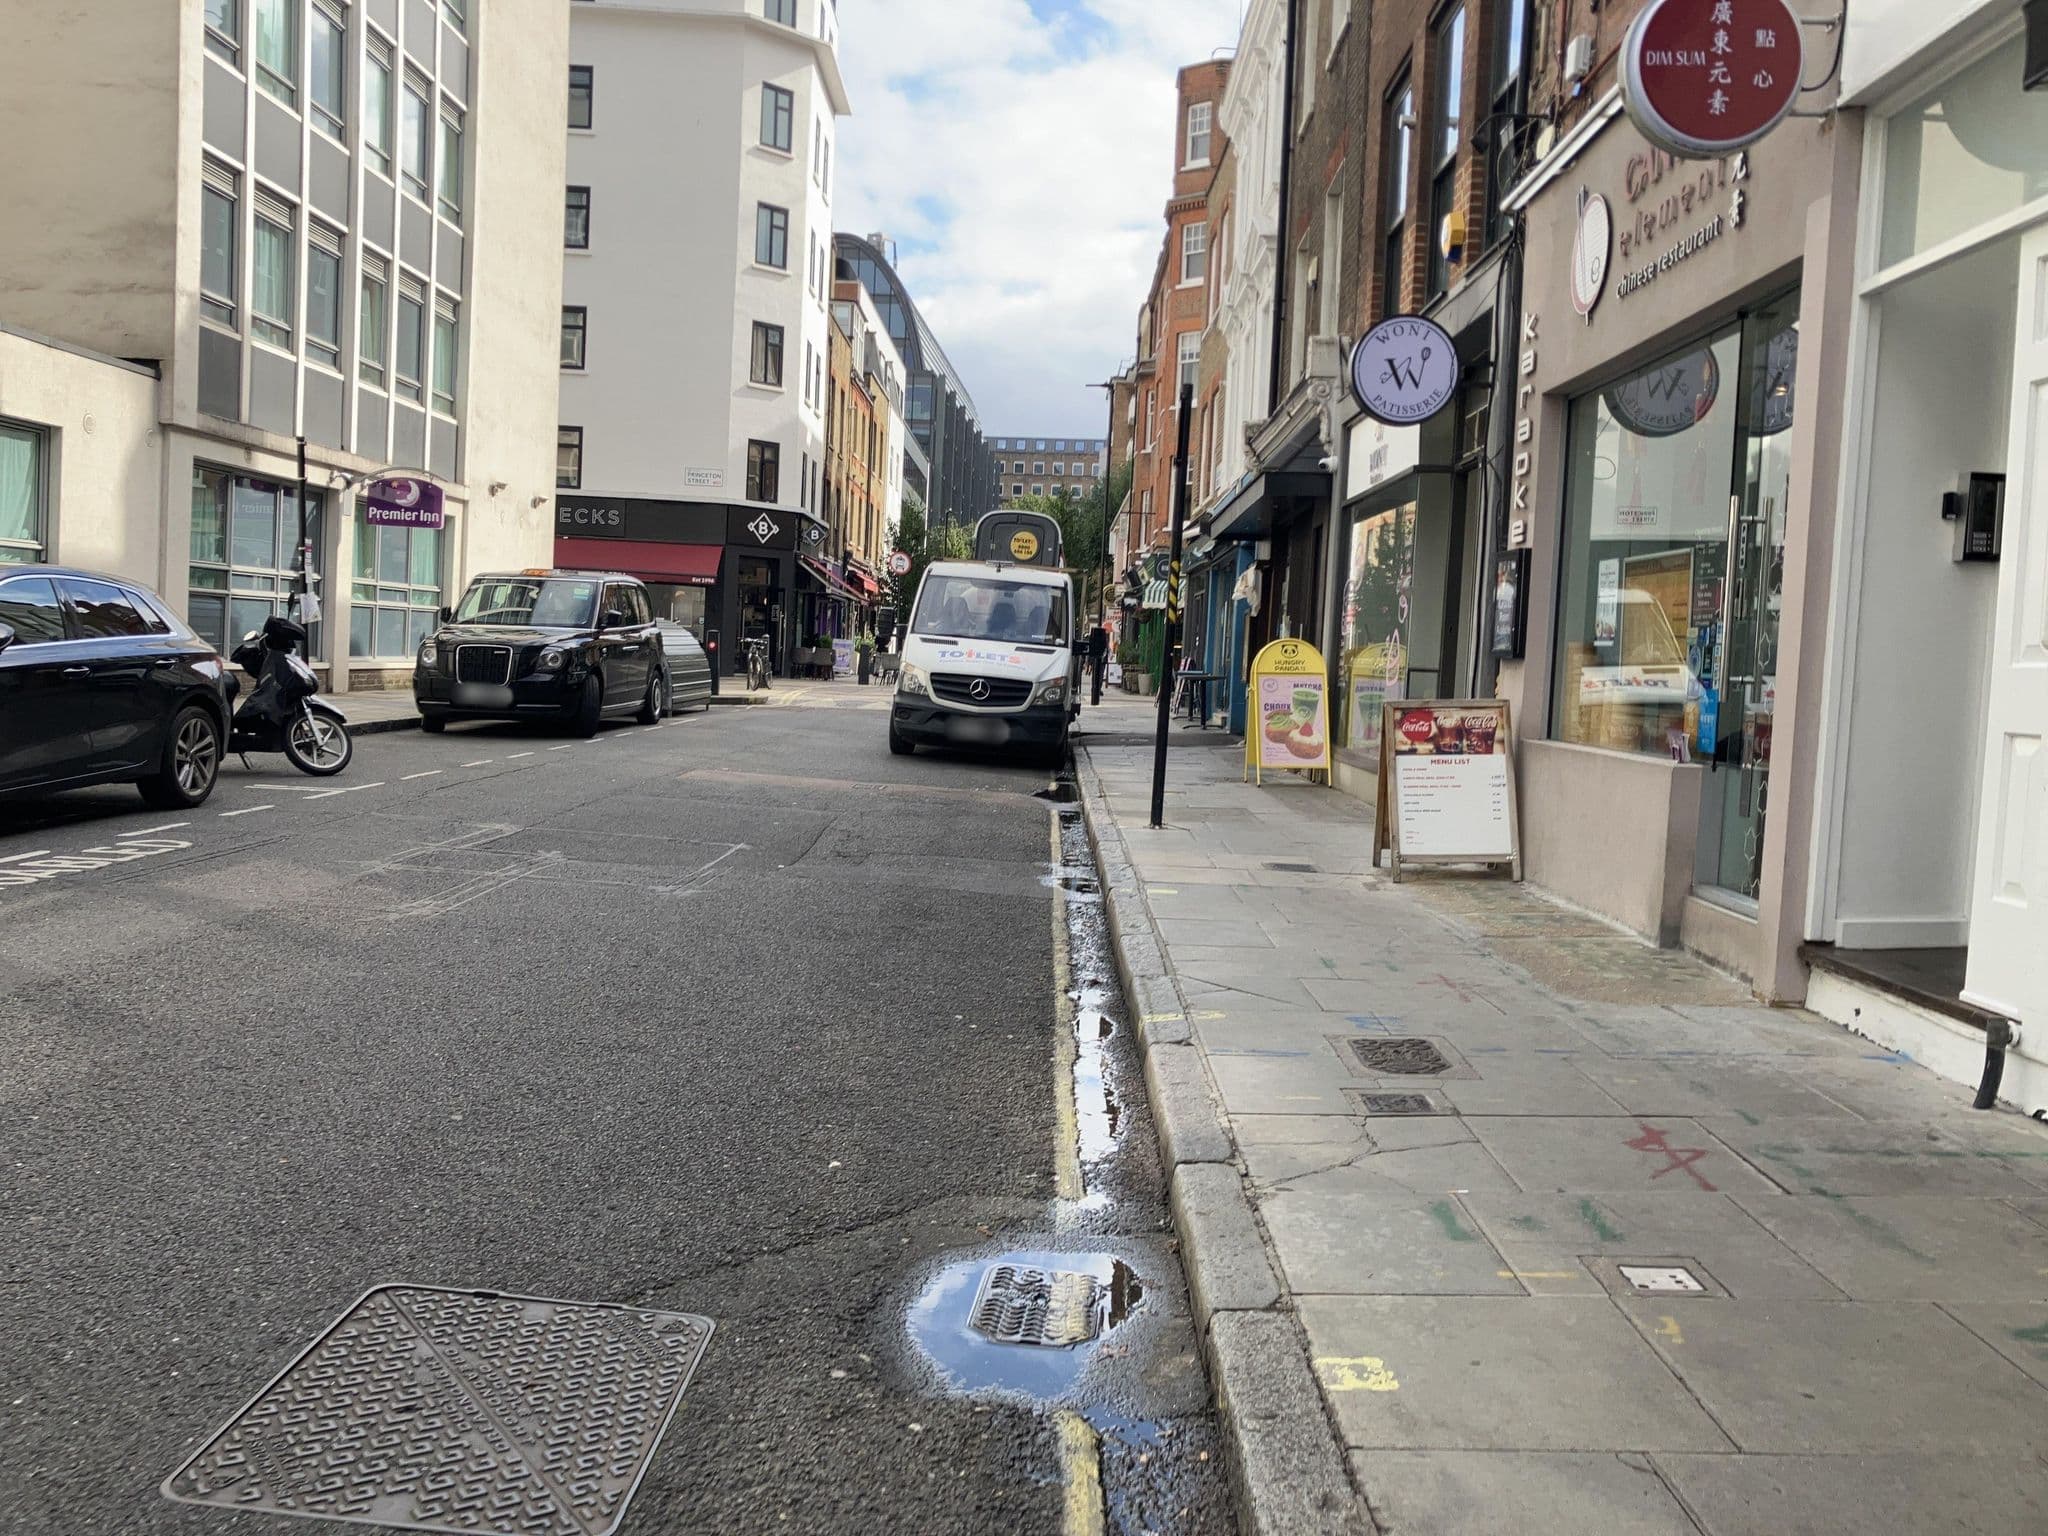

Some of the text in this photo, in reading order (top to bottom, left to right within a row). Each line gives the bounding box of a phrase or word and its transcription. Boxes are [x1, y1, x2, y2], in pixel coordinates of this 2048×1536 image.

[1646, 51, 1706, 66] DIM SUM
[1708, 0, 1733, 116] 廣東元素
[1753, 29, 1776, 88] 點心
[1616, 214, 1724, 299] chinese restaurant
[1375, 324, 1431, 345] WONI
[1373, 388, 1443, 416] PATISSERIE
[687, 471, 722, 479] PRINCETON
[368, 507, 440, 522] Premier Inn
[559, 507, 621, 526] ECKS
[759, 521, 768, 534] B
[438, 1346, 542, 1449] DREADNOUGHT
